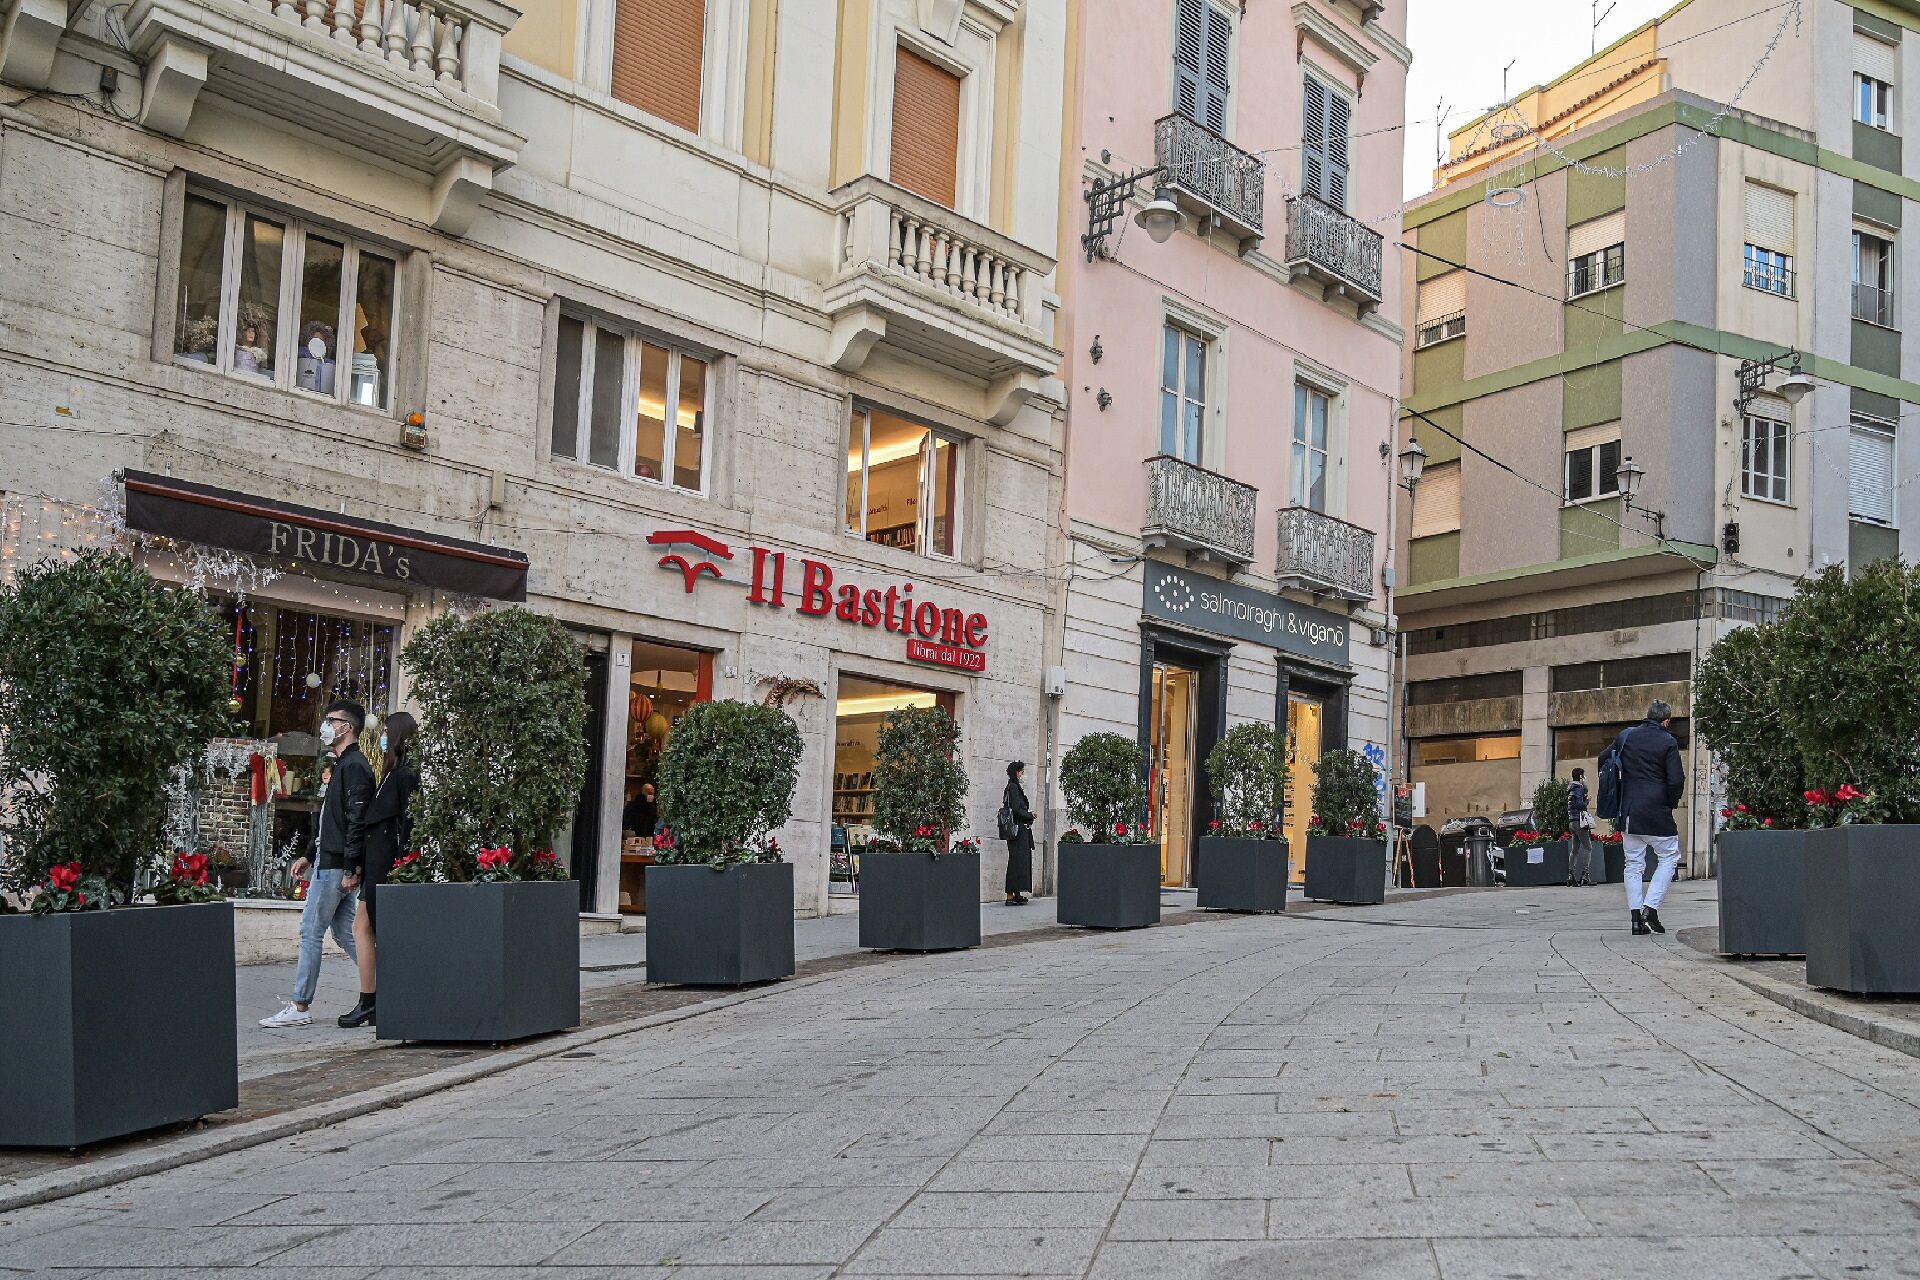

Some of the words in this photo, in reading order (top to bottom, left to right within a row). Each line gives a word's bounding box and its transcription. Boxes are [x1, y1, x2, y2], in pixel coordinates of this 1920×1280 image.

[267, 521, 410, 578] FRIDA's
[746, 546, 785, 608] Il
[796, 558, 989, 648] Bastione
[1200, 592, 1284, 633] salmoiraghi
[1287, 612, 1298, 634] &
[913, 641, 938, 660] librai
[941, 647, 956, 663] dal
[959, 651, 981, 668] 1922
